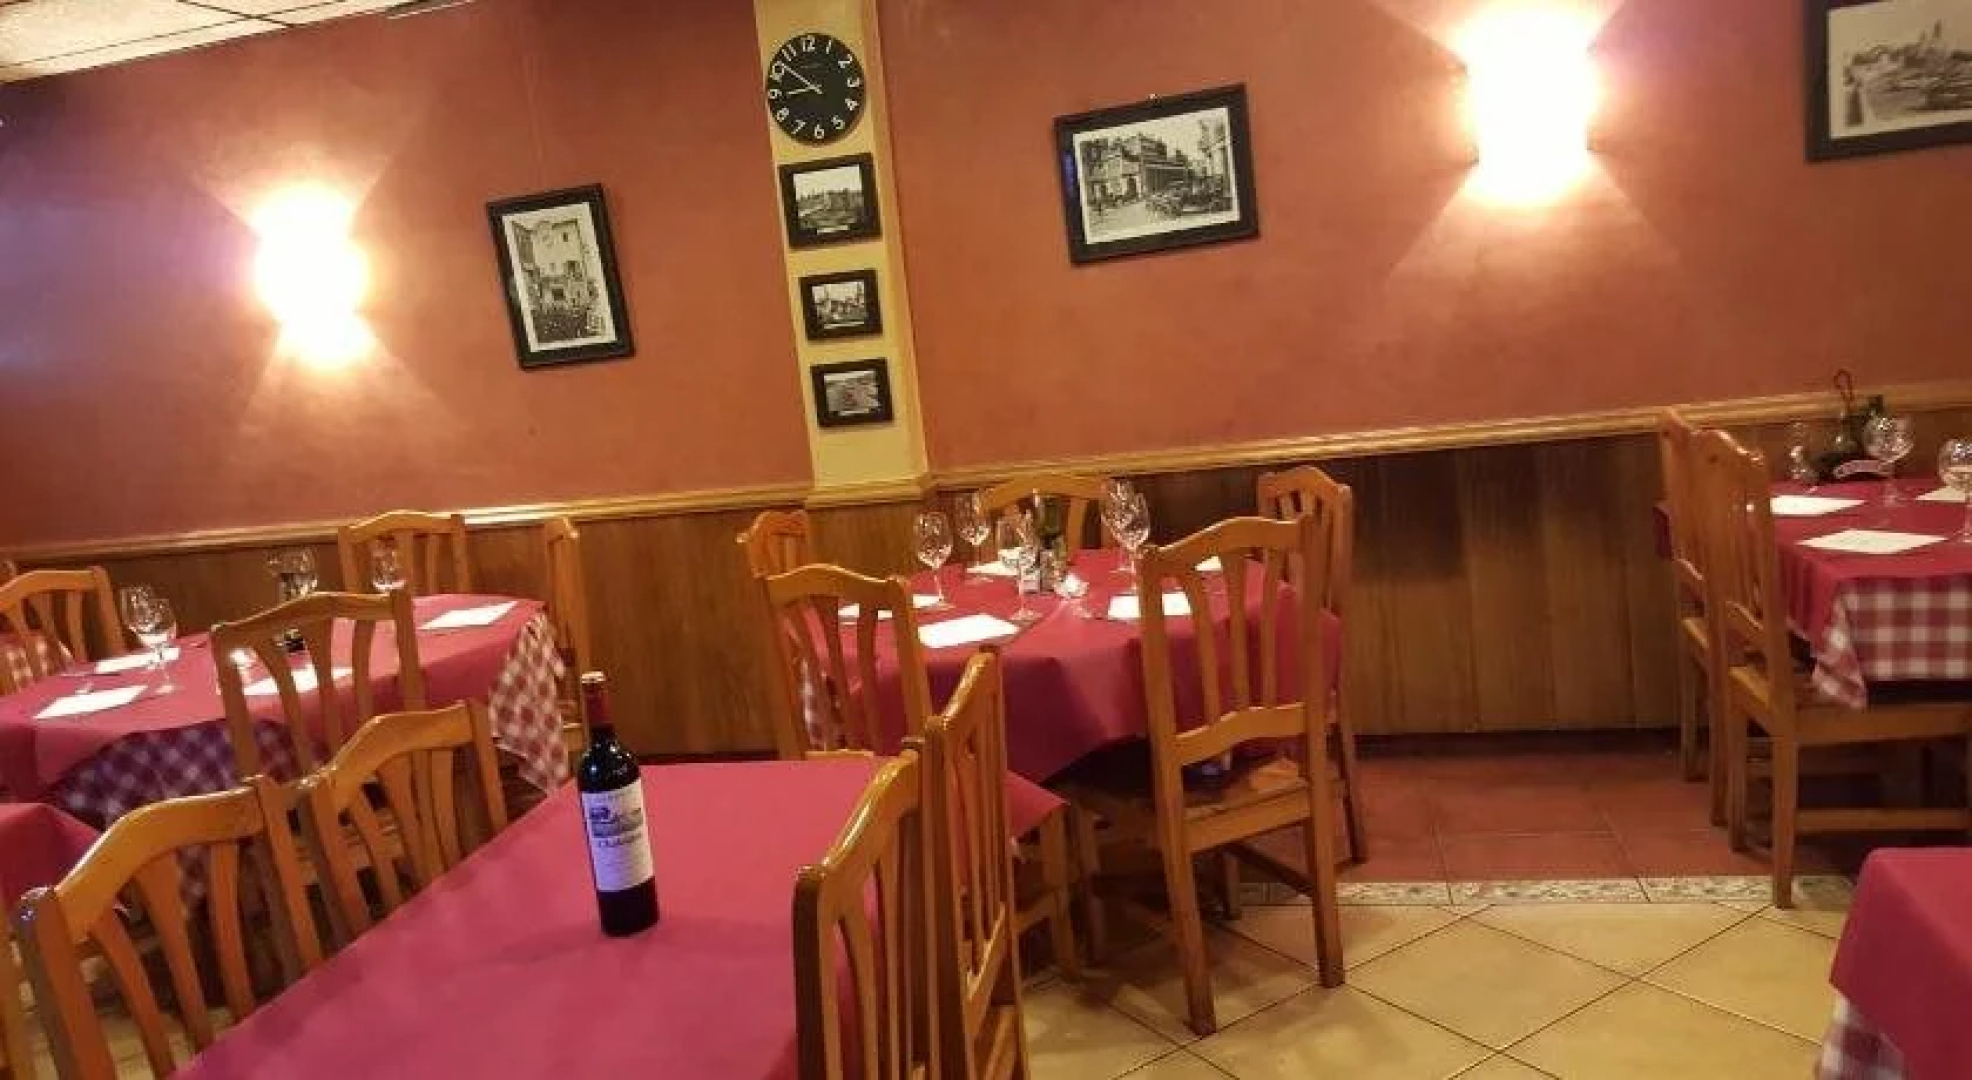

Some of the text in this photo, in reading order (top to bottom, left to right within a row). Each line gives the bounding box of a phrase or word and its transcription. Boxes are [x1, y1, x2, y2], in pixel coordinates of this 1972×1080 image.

[801, 35, 815, 52] 12
[826, 39, 833, 54] 1
[781, 44, 797, 62] 11
[838, 54, 853, 69] 2
[770, 61, 785, 82] 10
[847, 77, 860, 88] 3
[767, 88, 782, 100] 9
[845, 98, 859, 111] 4
[776, 107, 790, 122] 8
[791, 119, 806, 135] 7
[831, 115, 845, 130] 5
[814, 124, 825, 139] 6
